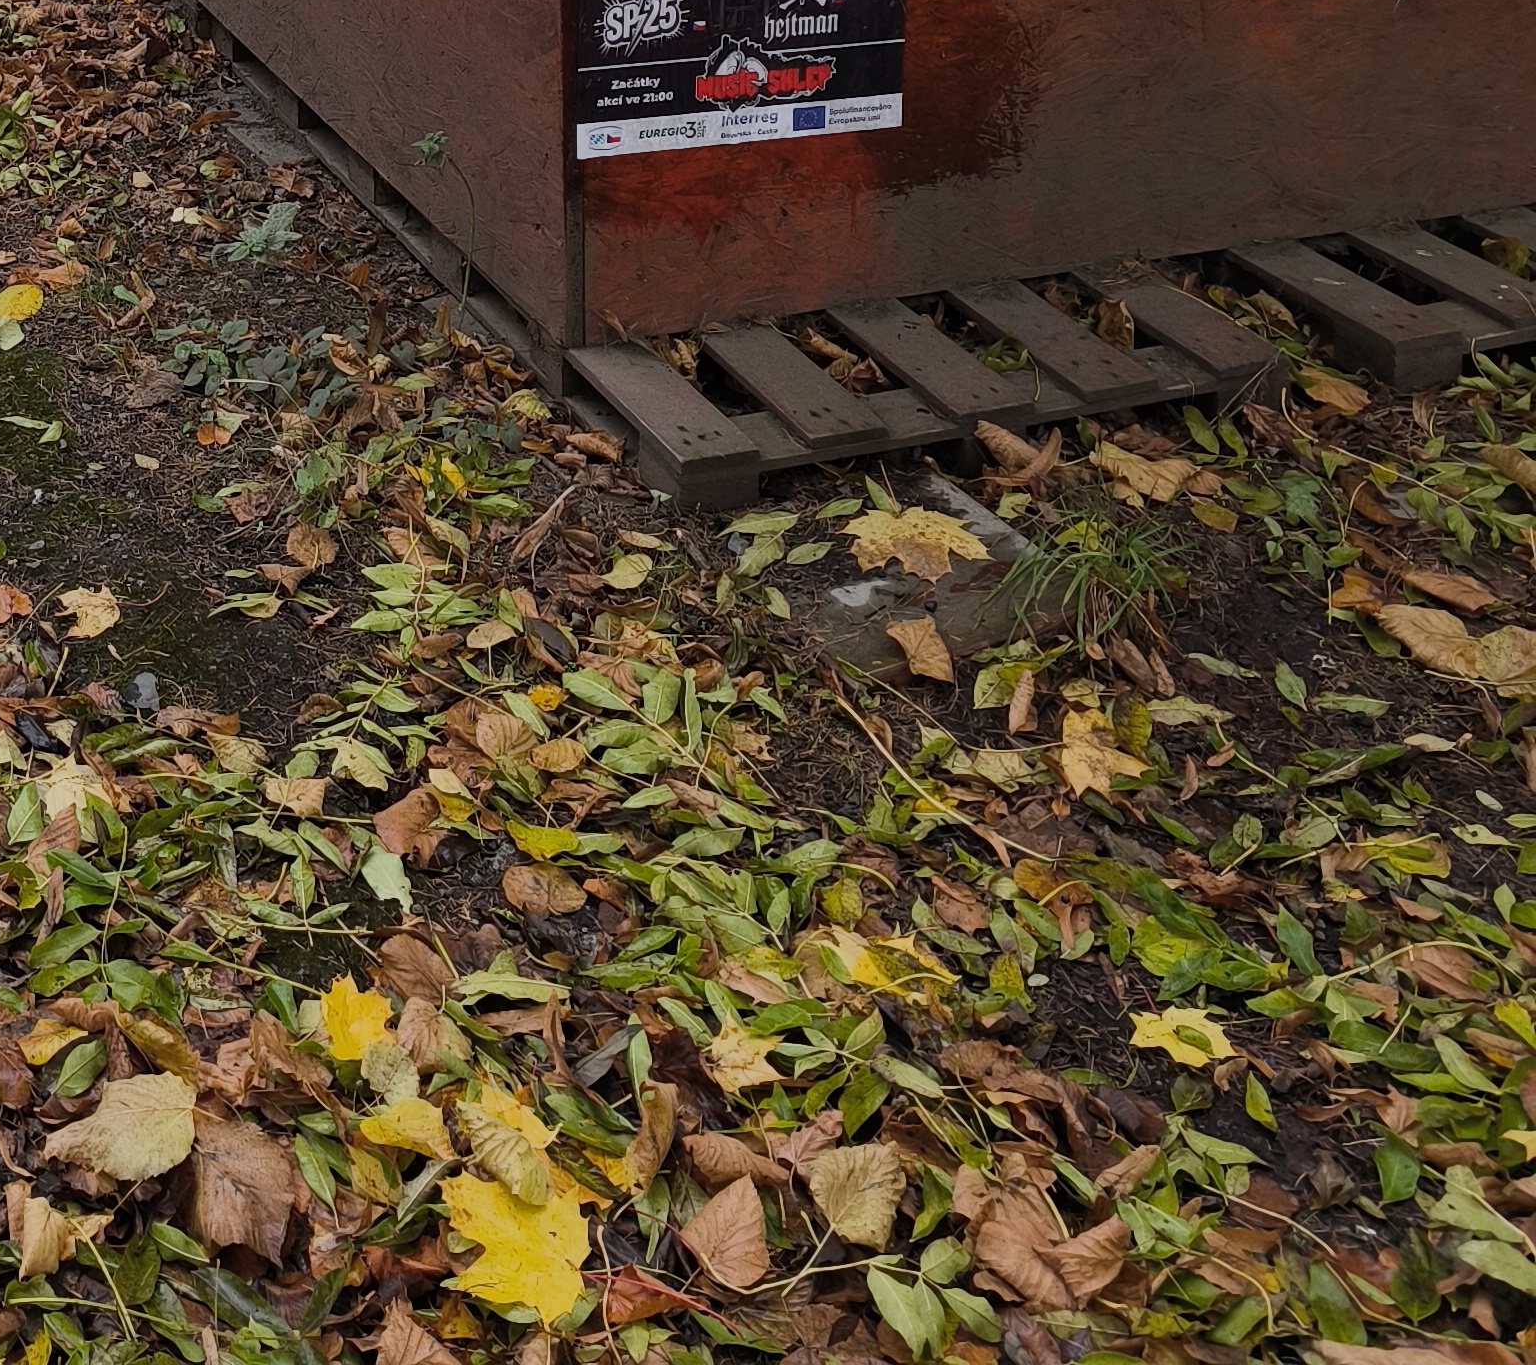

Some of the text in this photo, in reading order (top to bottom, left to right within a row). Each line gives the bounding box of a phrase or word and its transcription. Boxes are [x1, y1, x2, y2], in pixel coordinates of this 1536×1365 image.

[764, 13, 840, 43] hejtman
[611, 76, 661, 90] Začátky
[596, 91, 674, 108] akcí ve 21:00
[721, 112, 779, 127] Interreg
